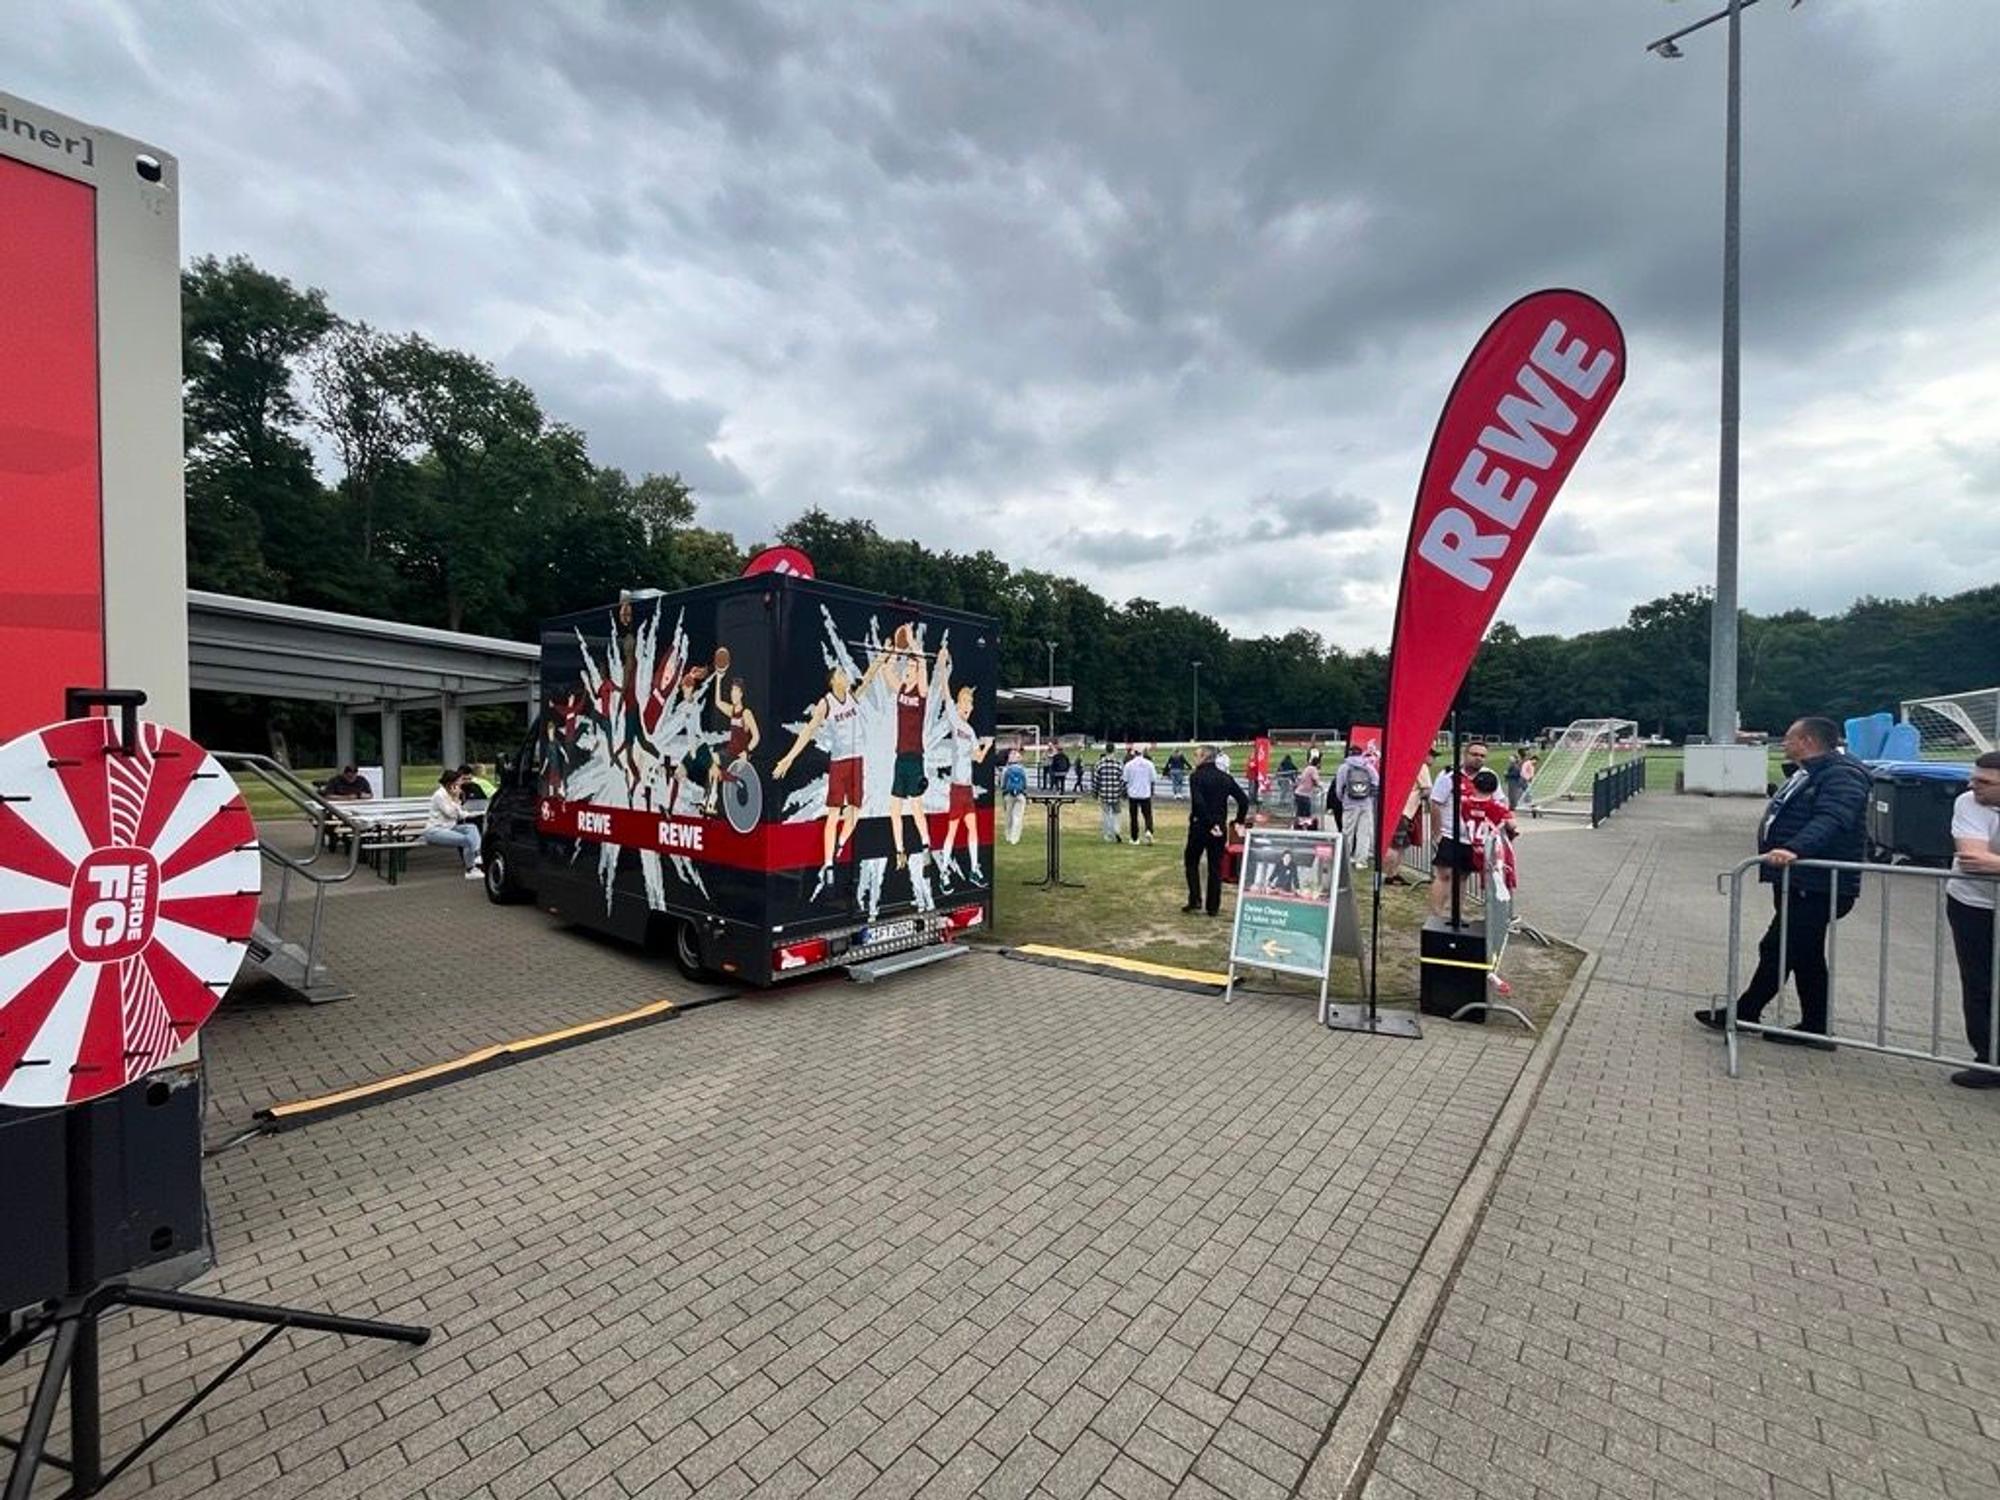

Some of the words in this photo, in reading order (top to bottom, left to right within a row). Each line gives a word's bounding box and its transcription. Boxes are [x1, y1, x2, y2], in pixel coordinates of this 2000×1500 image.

[1418, 319, 1615, 591] REWE
[577, 810, 611, 835] REWE
[658, 821, 703, 850] REWE
[82, 865, 130, 947] FC
[127, 864, 148, 940] WERDE
